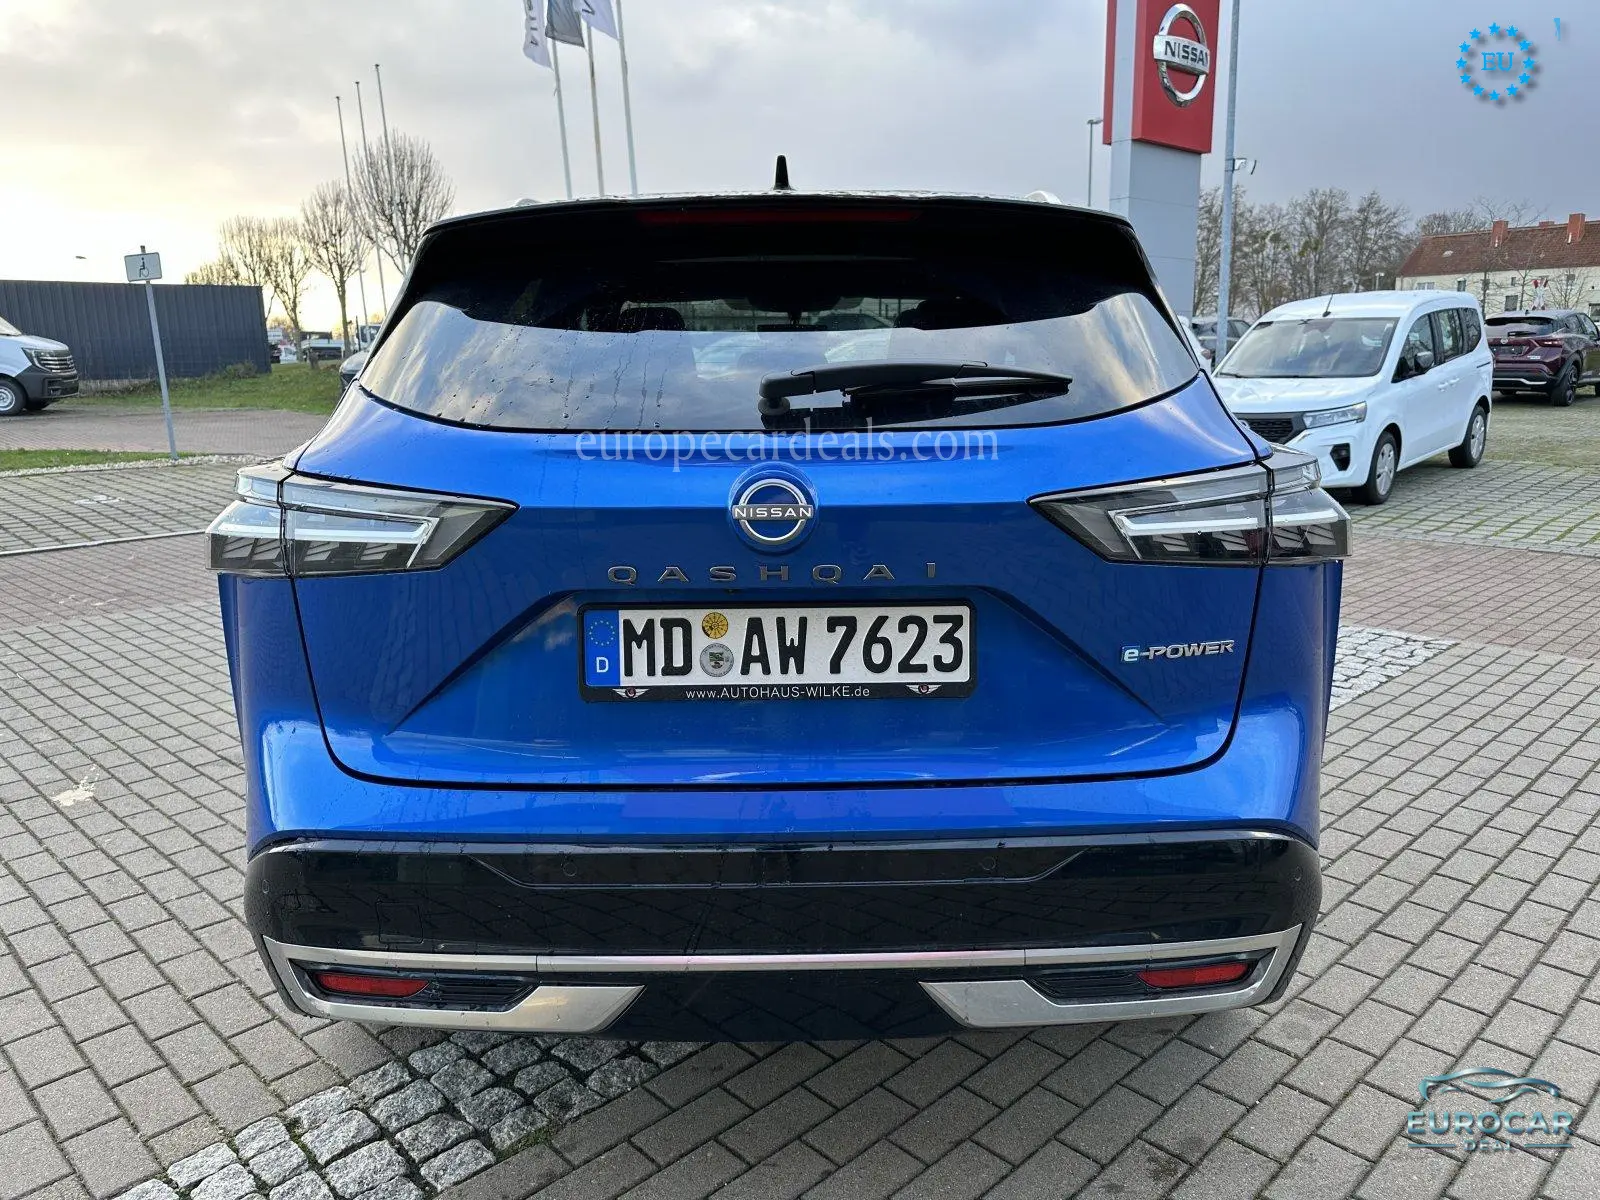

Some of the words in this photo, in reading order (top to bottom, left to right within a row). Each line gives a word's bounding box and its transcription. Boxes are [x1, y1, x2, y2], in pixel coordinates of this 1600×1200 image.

[734, 507, 812, 518] NISSAN
[607, 562, 937, 585] QASHQAI
[622, 617, 693, 677] MD
[740, 616, 807, 676] AW
[826, 614, 964, 675] 7623
[1122, 640, 1235, 661] e-POWER
[596, 656, 609, 673] D
[685, 685, 870, 699] www.AUTOHAUS-WILKE.de
